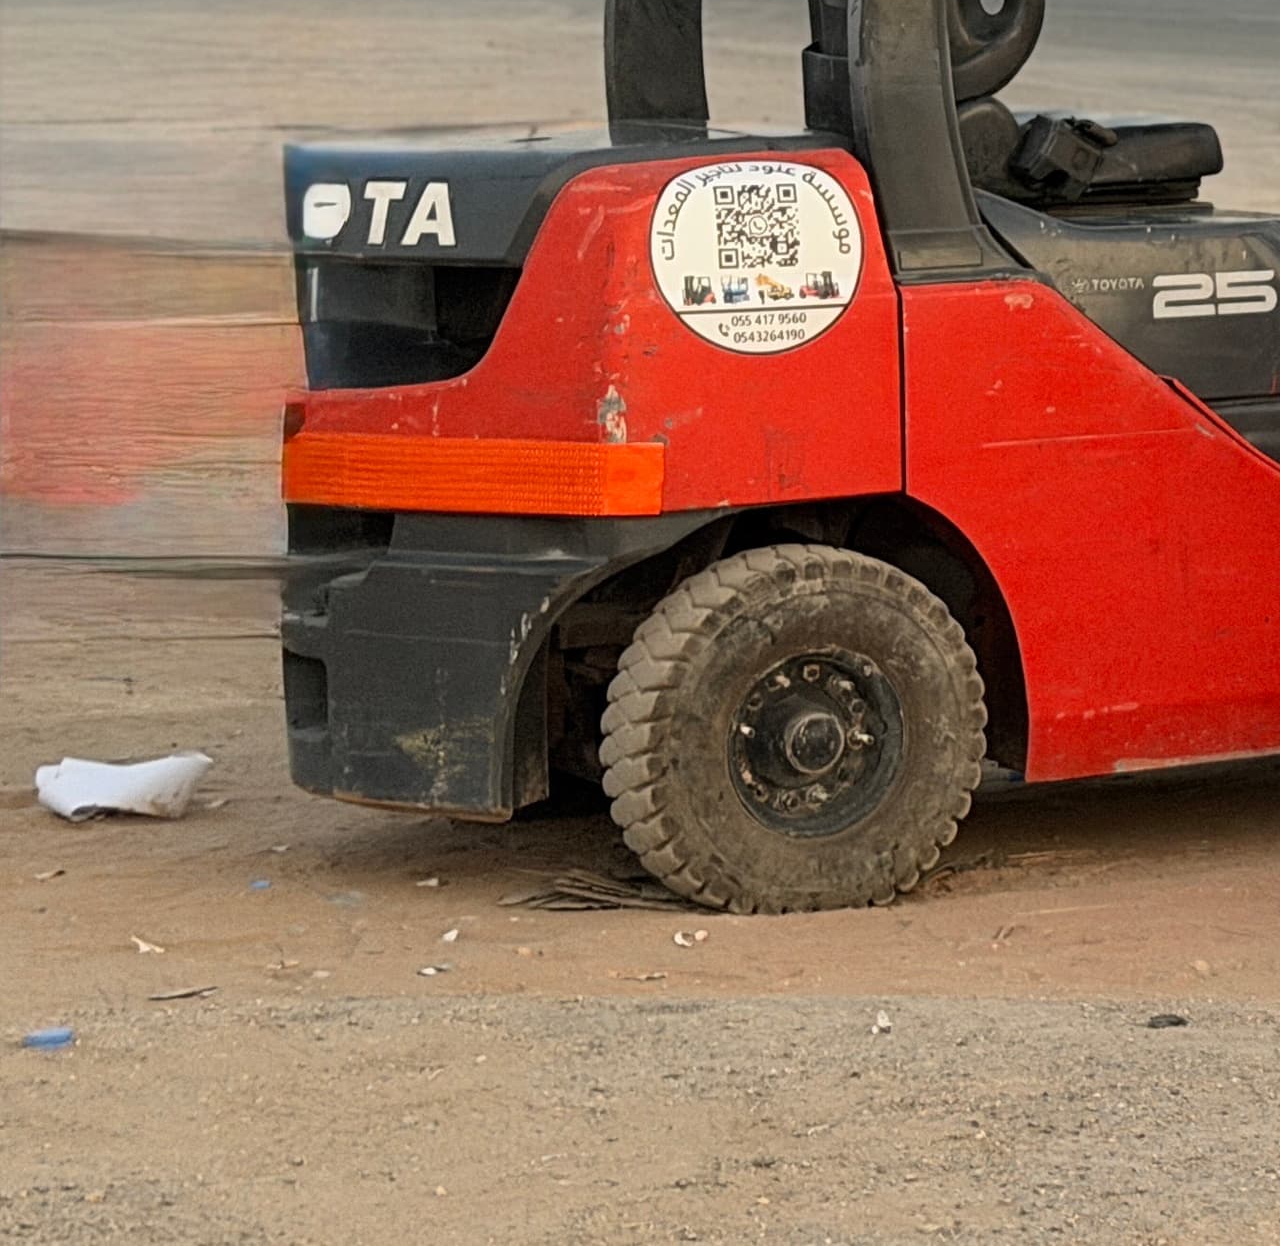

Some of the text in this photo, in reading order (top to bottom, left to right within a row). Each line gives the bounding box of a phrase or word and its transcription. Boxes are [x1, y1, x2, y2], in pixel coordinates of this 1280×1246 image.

[1091, 269, 1279, 319] TOYOTA 25
[731, 311, 807, 328] 055 417 9560
[733, 328, 806, 344] 0543264190
